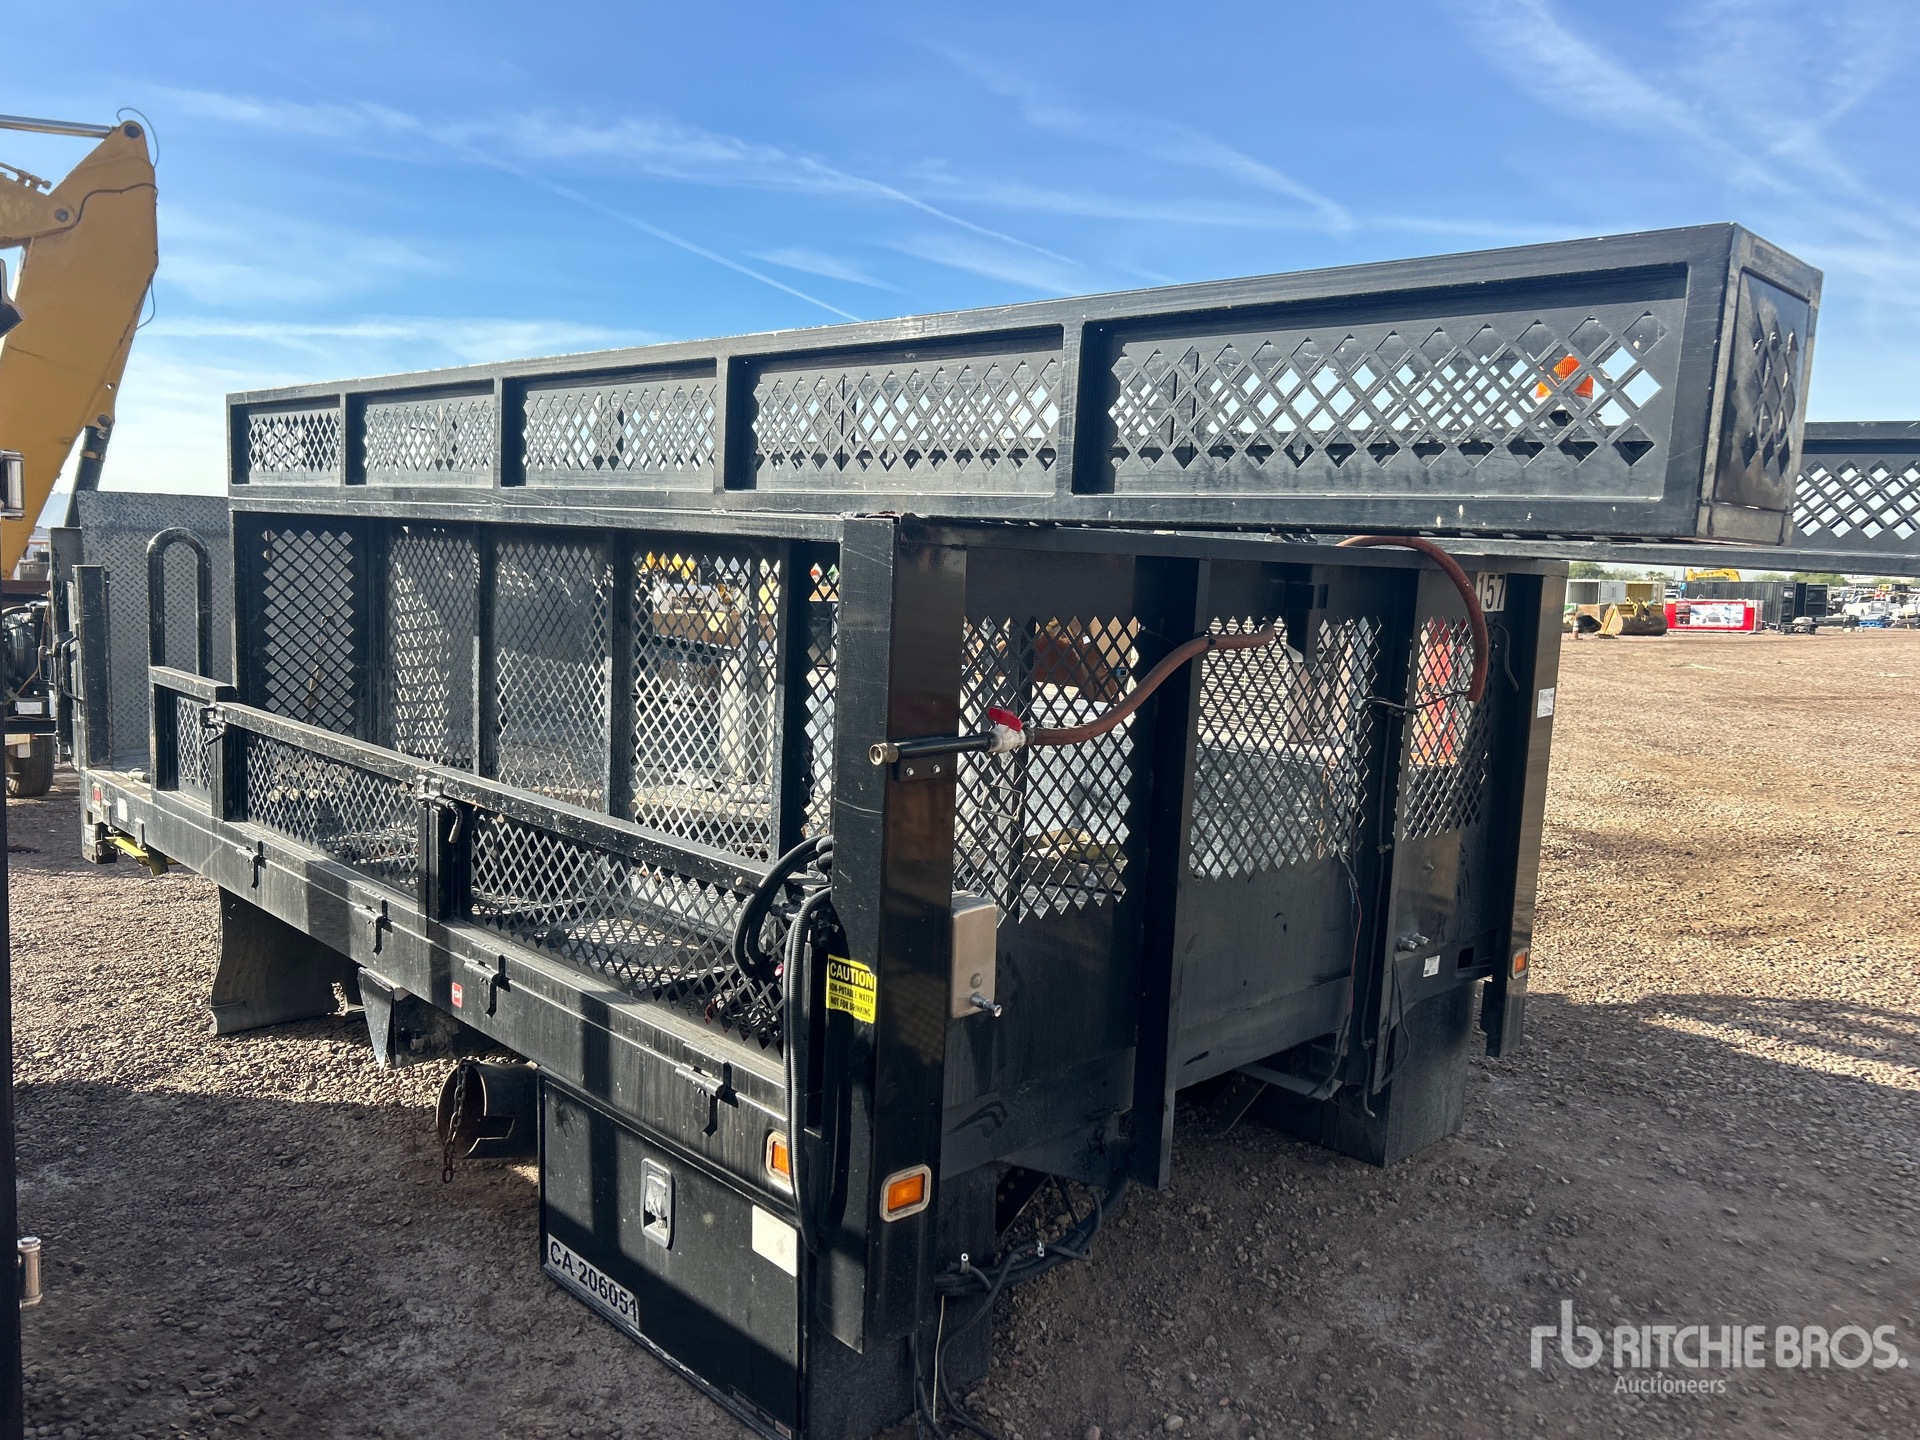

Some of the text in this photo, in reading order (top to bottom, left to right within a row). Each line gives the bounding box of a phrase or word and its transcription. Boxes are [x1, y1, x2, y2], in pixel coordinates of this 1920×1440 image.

[1480, 573, 1506, 610] 157
[830, 962, 873, 990] CAUTION
[830, 995, 840, 1007] NOT
[840, 998, 849, 1010] FOR
[858, 990, 874, 1004] WATER
[550, 1241, 638, 1323] CA 206051
